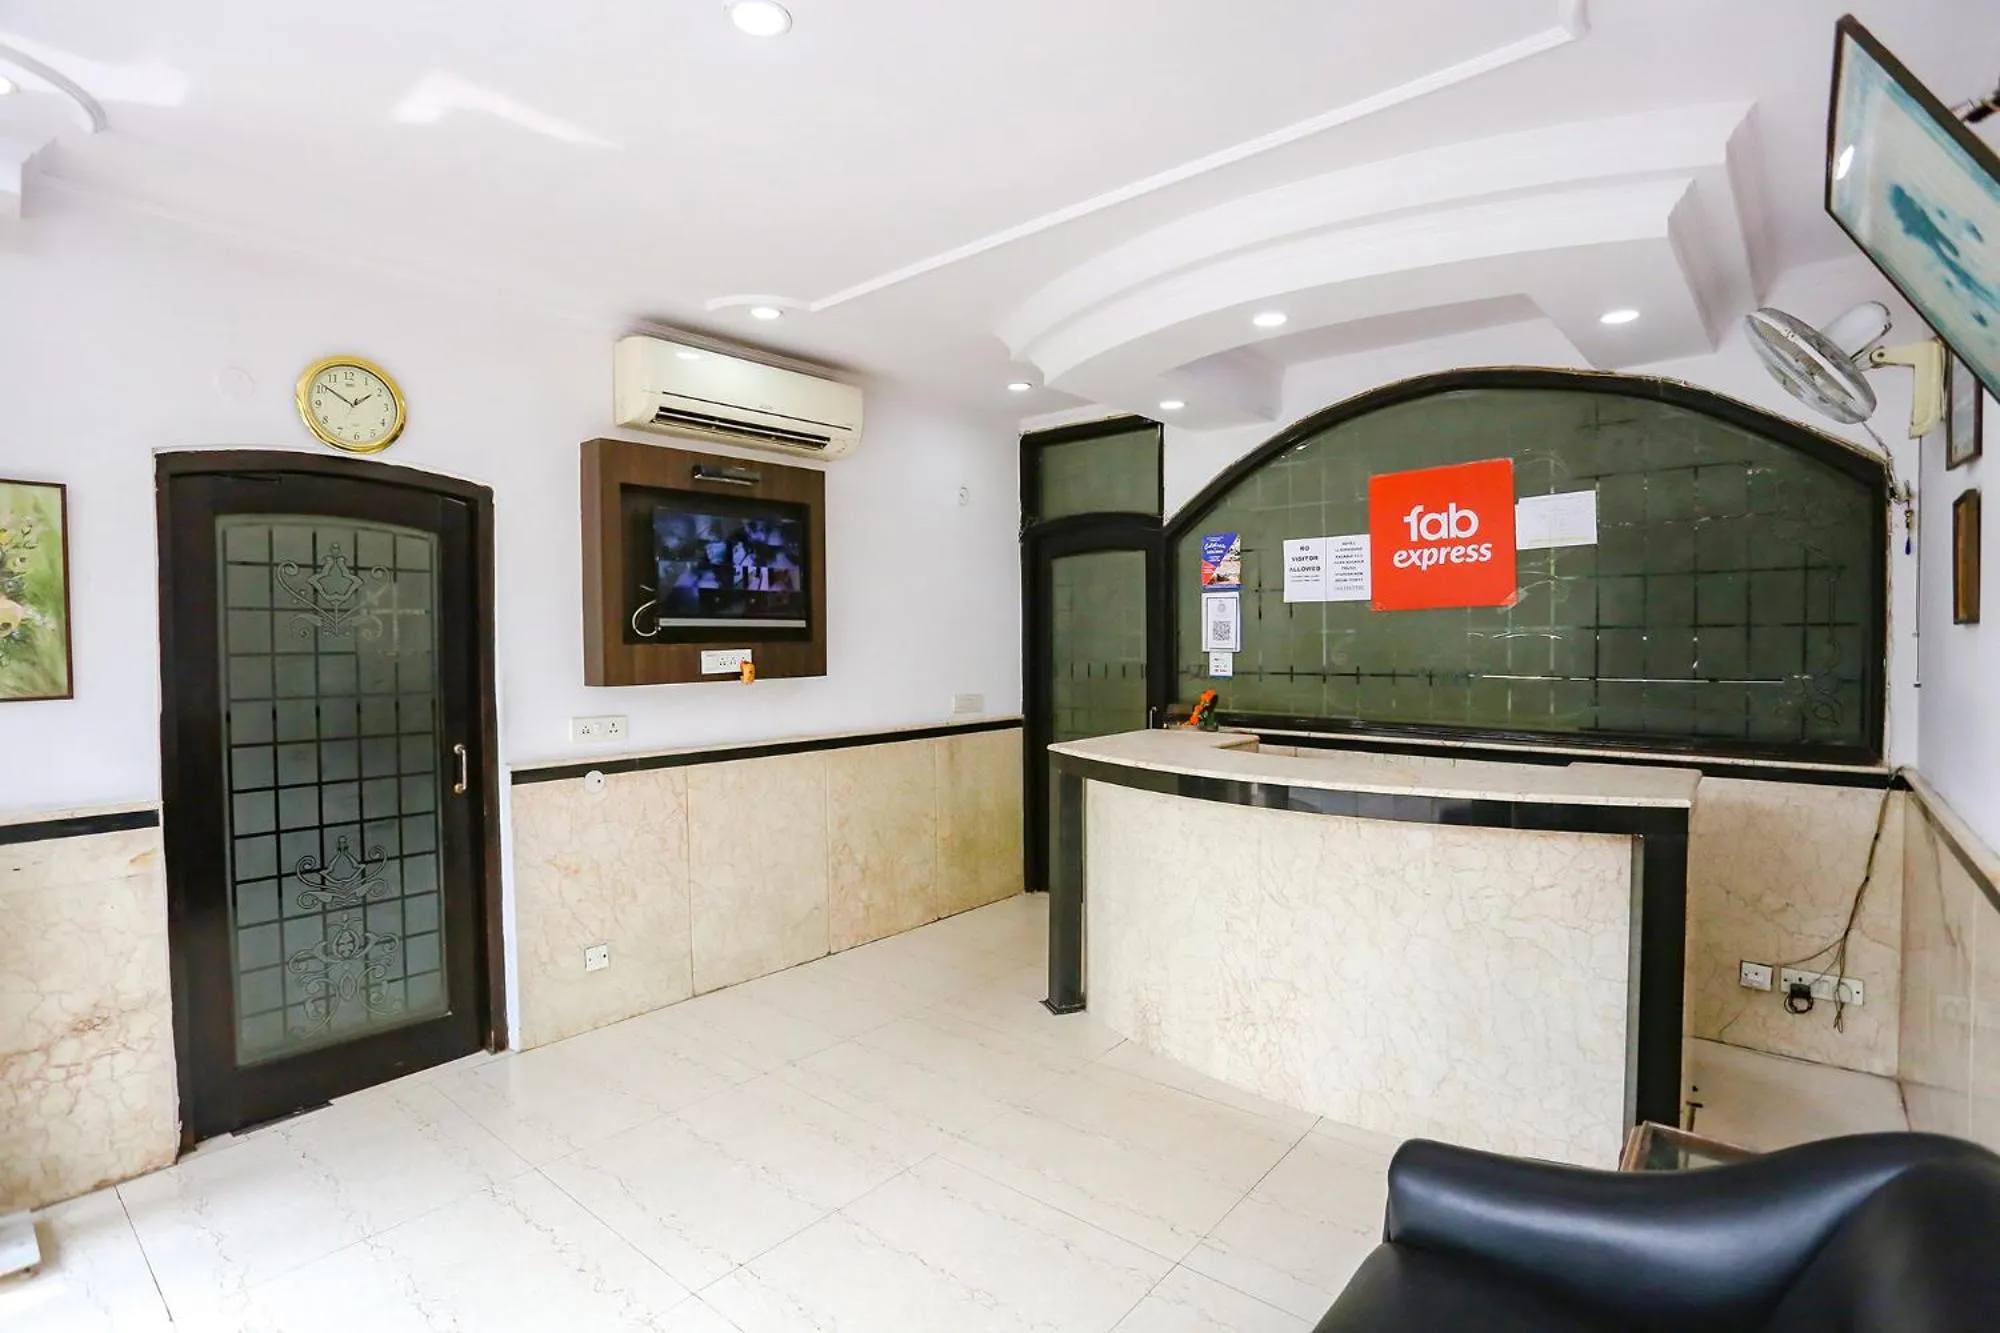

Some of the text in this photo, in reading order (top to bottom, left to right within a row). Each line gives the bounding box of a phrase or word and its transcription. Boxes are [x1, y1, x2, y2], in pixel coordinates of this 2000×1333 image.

[328, 374, 337, 383] 11
[344, 371, 355, 381] 12
[364, 377, 369, 386] 1
[316, 384, 328, 394] 10
[376, 388, 382, 397] 2
[315, 400, 322, 408] 9
[384, 403, 389, 412] 3
[380, 418, 386, 427] 4
[337, 427, 343, 436] 7
[370, 428, 376, 438] 5
[354, 432, 360, 441] 6
[1403, 502, 1479, 542] fab
[1393, 543, 1493, 571] express
[1289, 565, 1321, 573] ALLOWED
